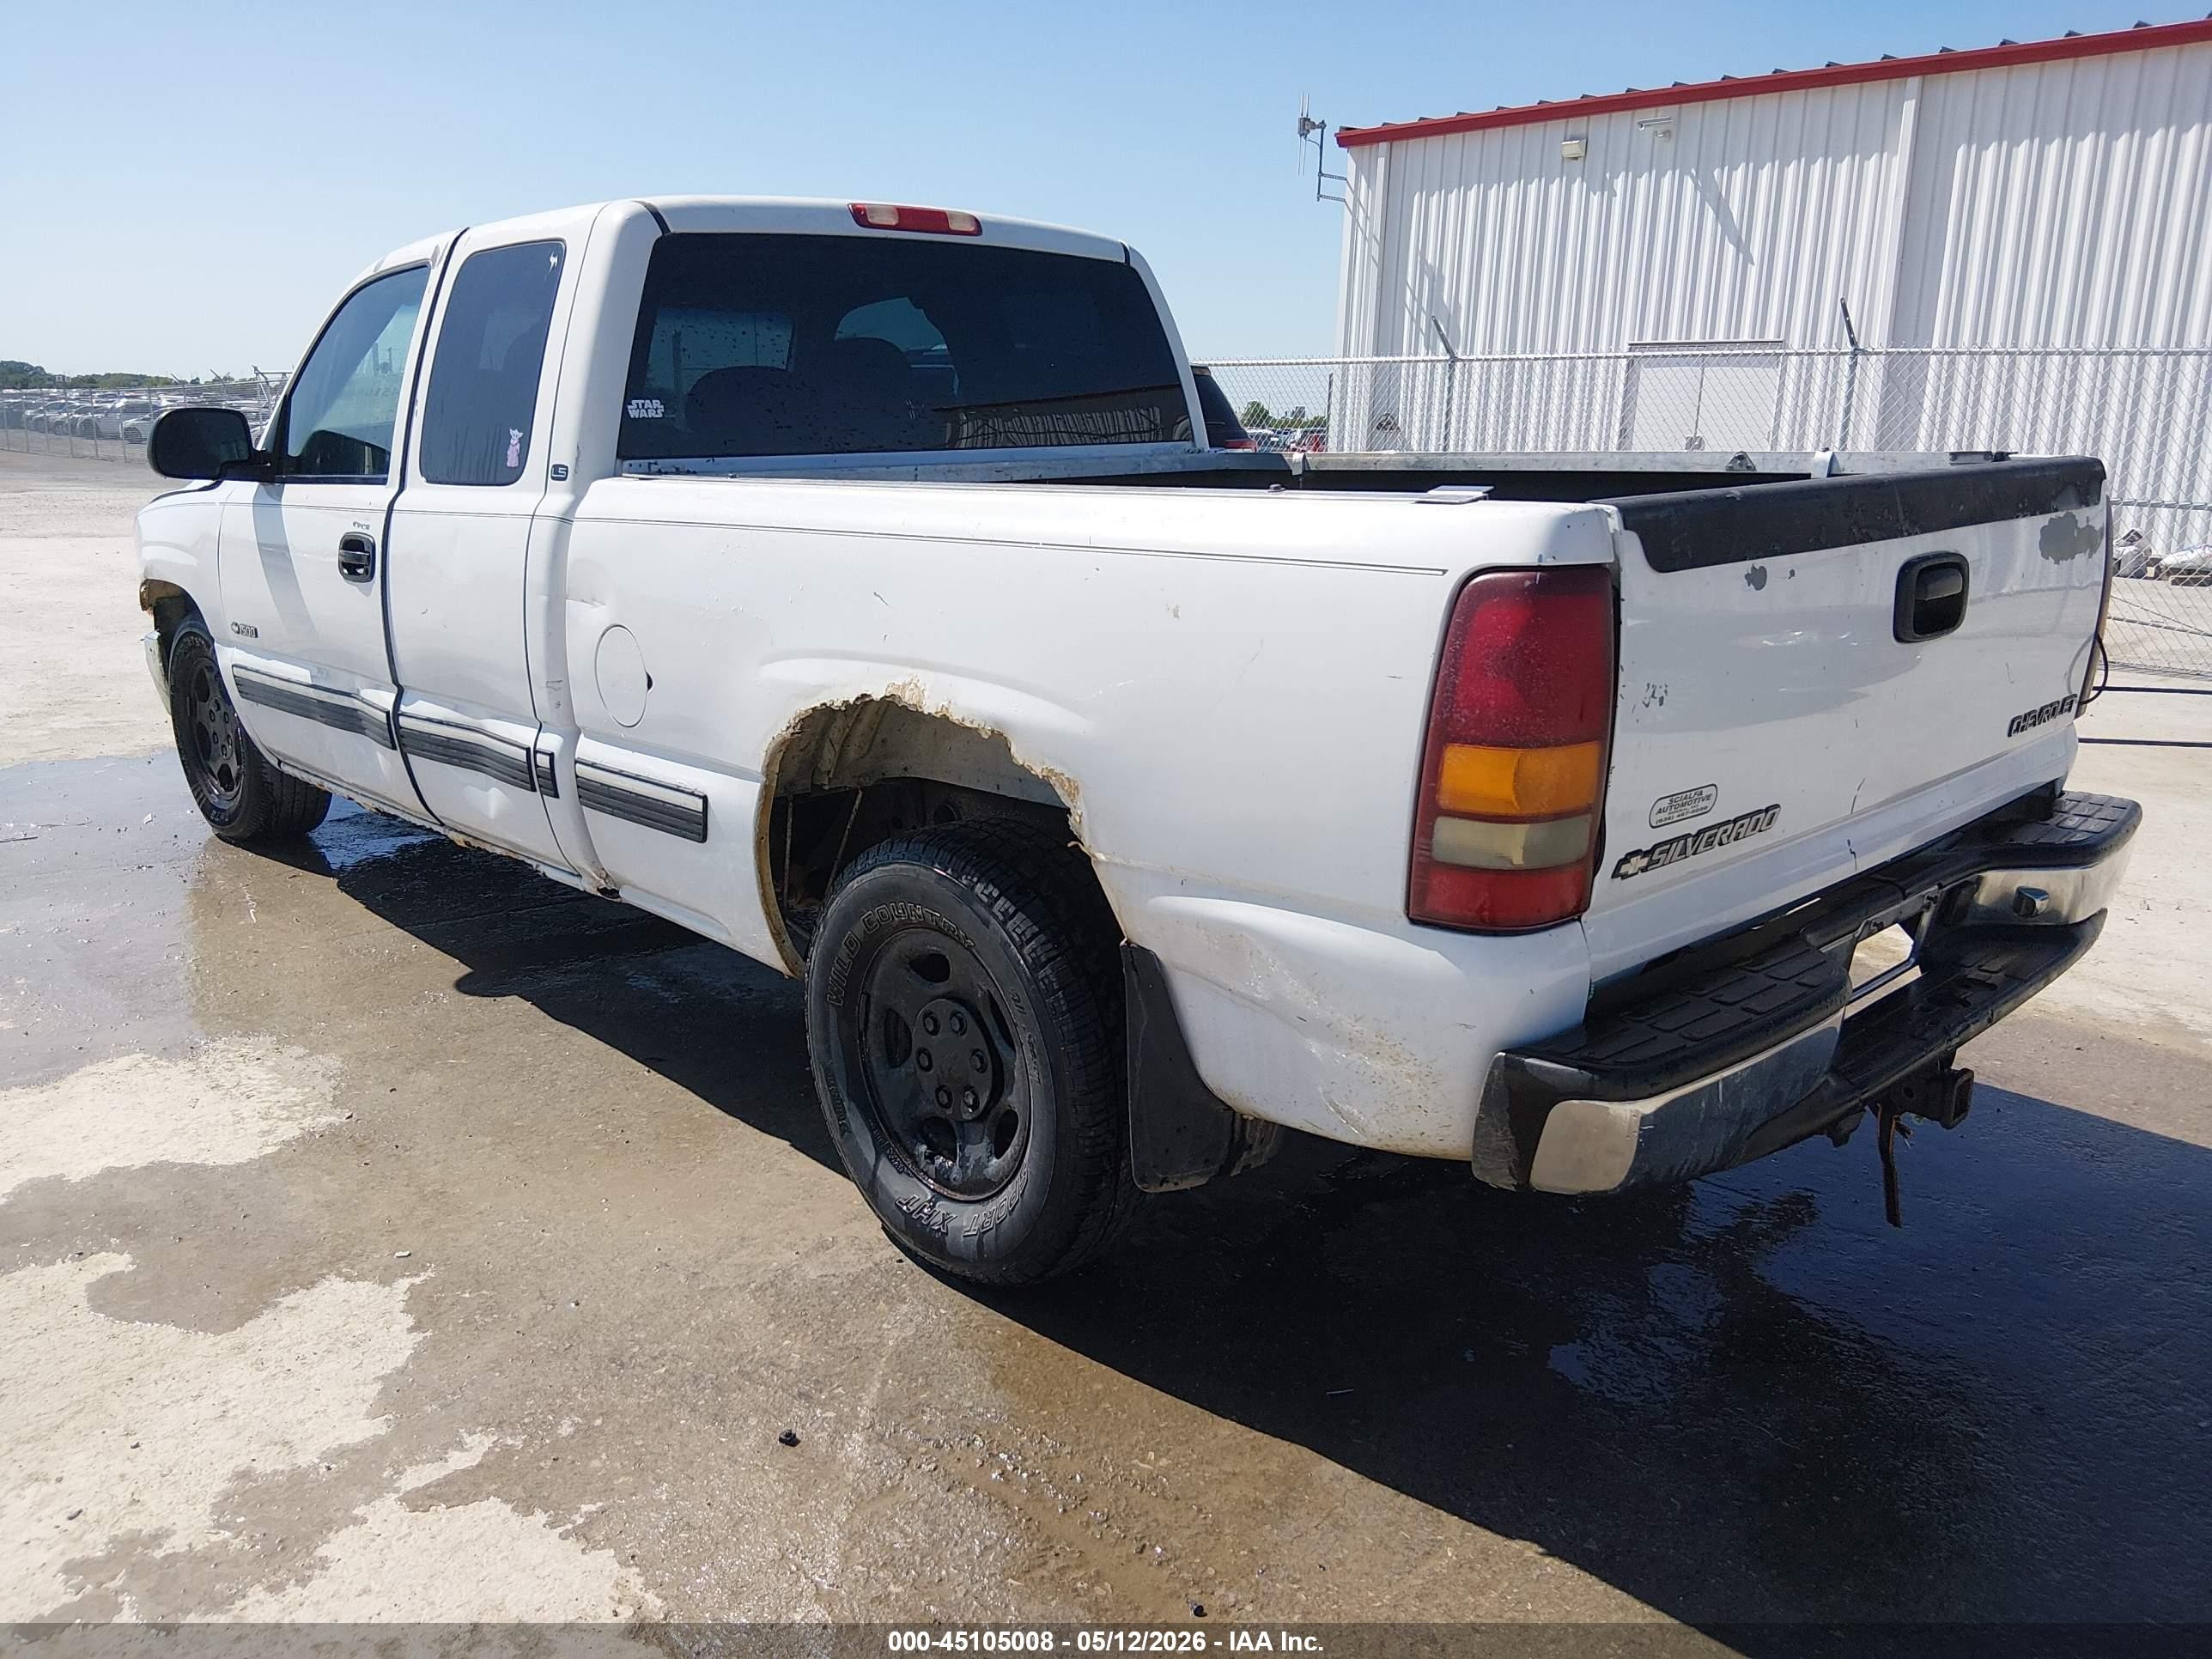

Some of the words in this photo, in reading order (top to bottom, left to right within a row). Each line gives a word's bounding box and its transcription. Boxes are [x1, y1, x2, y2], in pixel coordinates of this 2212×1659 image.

[627, 399, 664, 410] STAR
[628, 408, 665, 418] WARS
[552, 466, 568, 478] LS
[1656, 793, 1713, 816] AUTOMOTIVE
[1647, 804, 1781, 872] SILVERADO
[825, 933, 862, 1007] WILD
[860, 901, 975, 949] COUNTRY
[895, 1194, 958, 1236] XHT
[963, 1168, 1030, 1237] SPORT
